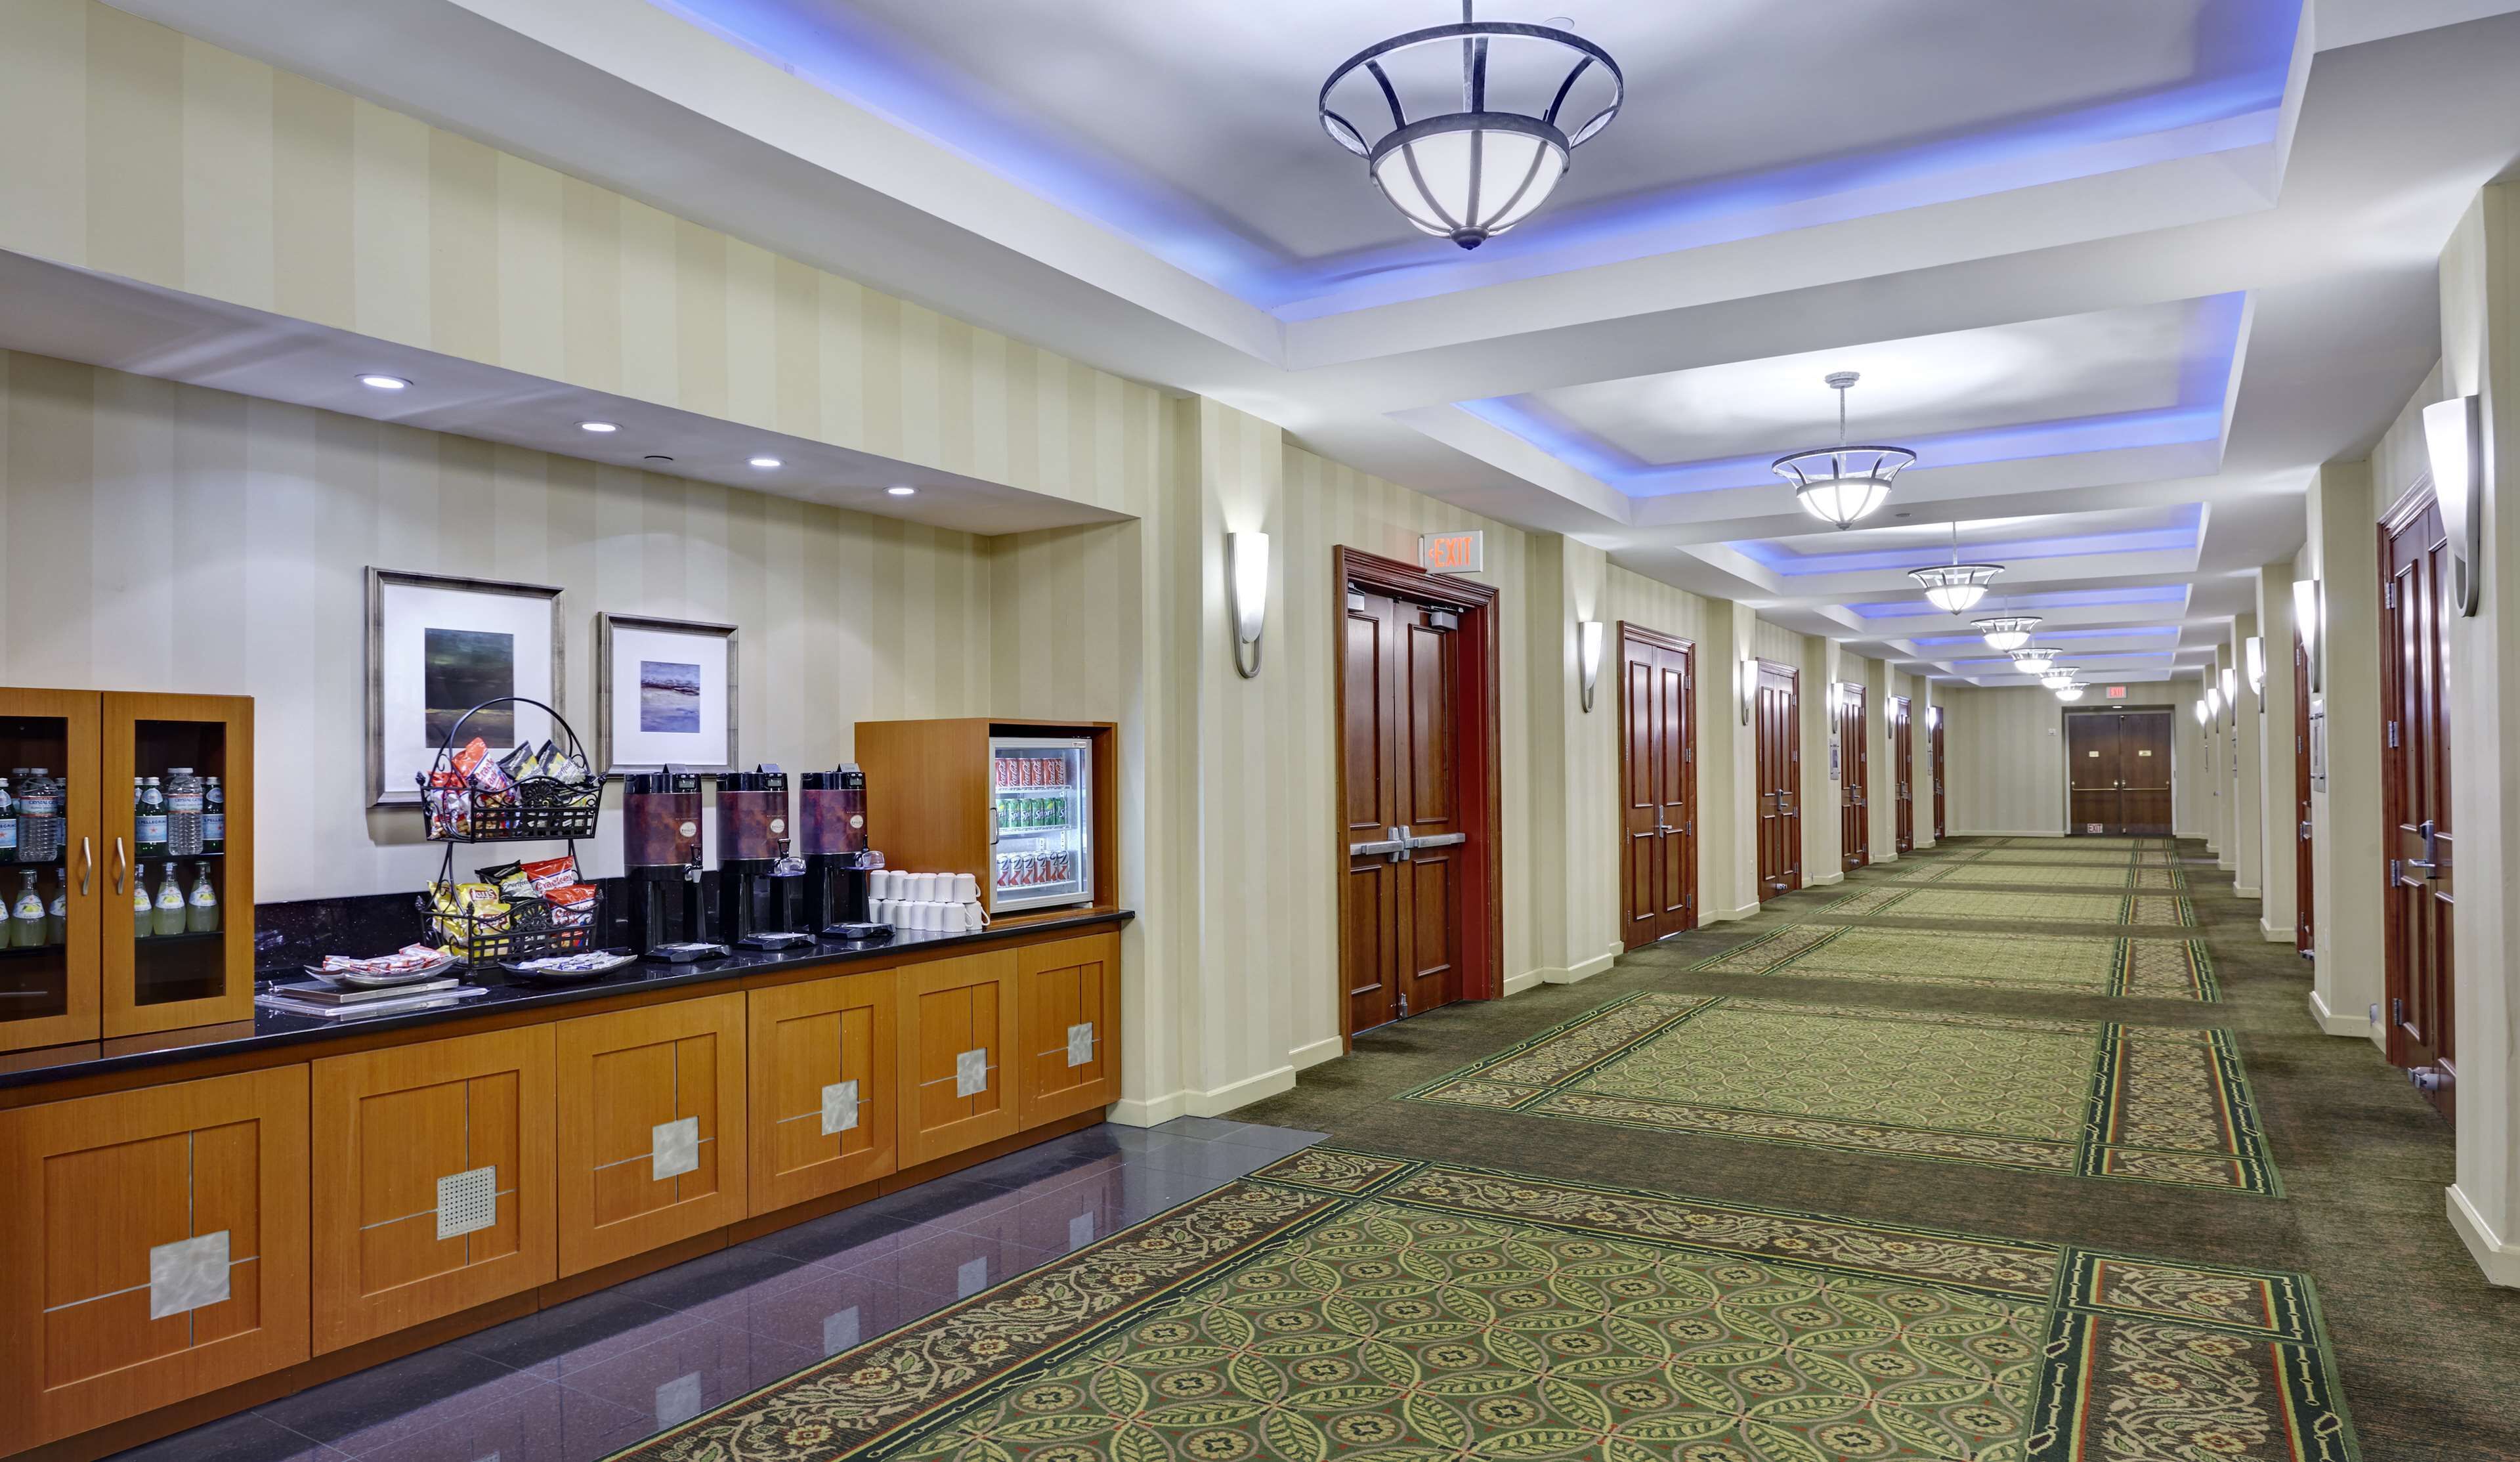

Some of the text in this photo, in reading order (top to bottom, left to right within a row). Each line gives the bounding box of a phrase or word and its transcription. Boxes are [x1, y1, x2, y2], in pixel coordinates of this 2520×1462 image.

[1434, 536, 1473, 568] EXIT
[2110, 687, 2124, 697] EXIT
[2089, 824, 2101, 832] EXIT
